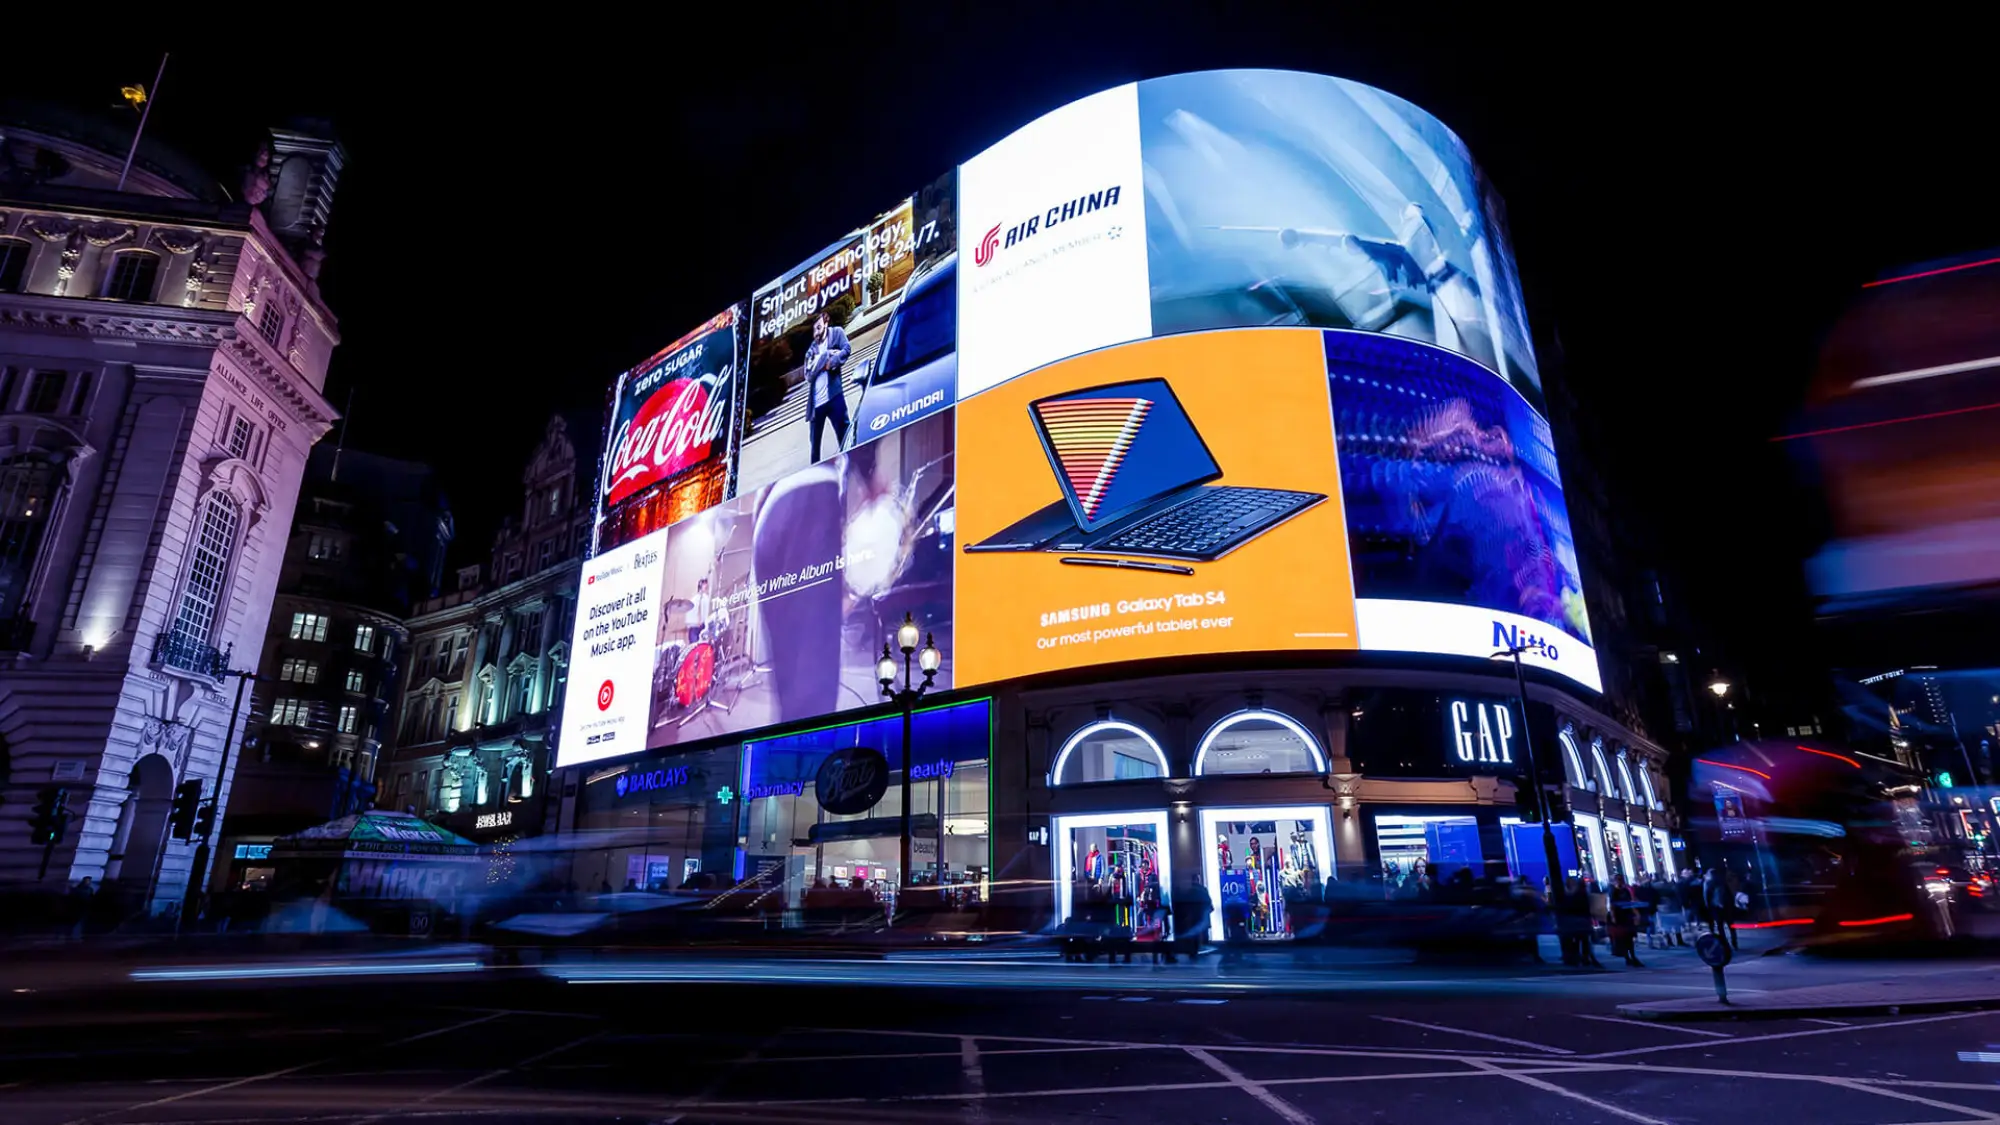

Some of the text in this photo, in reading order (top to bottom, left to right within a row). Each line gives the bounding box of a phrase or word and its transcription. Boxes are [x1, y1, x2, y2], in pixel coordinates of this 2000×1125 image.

[1004, 185, 1122, 249] AIR CHINA
[759, 219, 940, 339] keeping you safe 24/7.
[761, 220, 905, 316] Smart Technology,
[634, 344, 703, 396] zero SUGAR
[216, 363, 287, 431] ALLIANCE LIFE OFFICE
[891, 389, 944, 421] HYUNDAI
[711, 597, 728, 610] The
[729, 580, 769, 605] remixed
[769, 573, 797, 592] White
[798, 561, 833, 583] Album
[835, 555, 845, 570] is
[589, 586, 646, 620] Discover it all
[1040, 591, 1226, 627] SAMSUNG Galaxy Tab S4
[583, 608, 648, 640] on the YouTube
[1037, 616, 1233, 649] Our most powerful tablet ever
[1492, 620, 1558, 661] Nitto
[591, 633, 636, 657] Music app.
[1451, 700, 1513, 763] GAP
[629, 766, 689, 793] BARCLAYS
[909, 758, 955, 779] eauty
[748, 780, 805, 799] pharmacy
